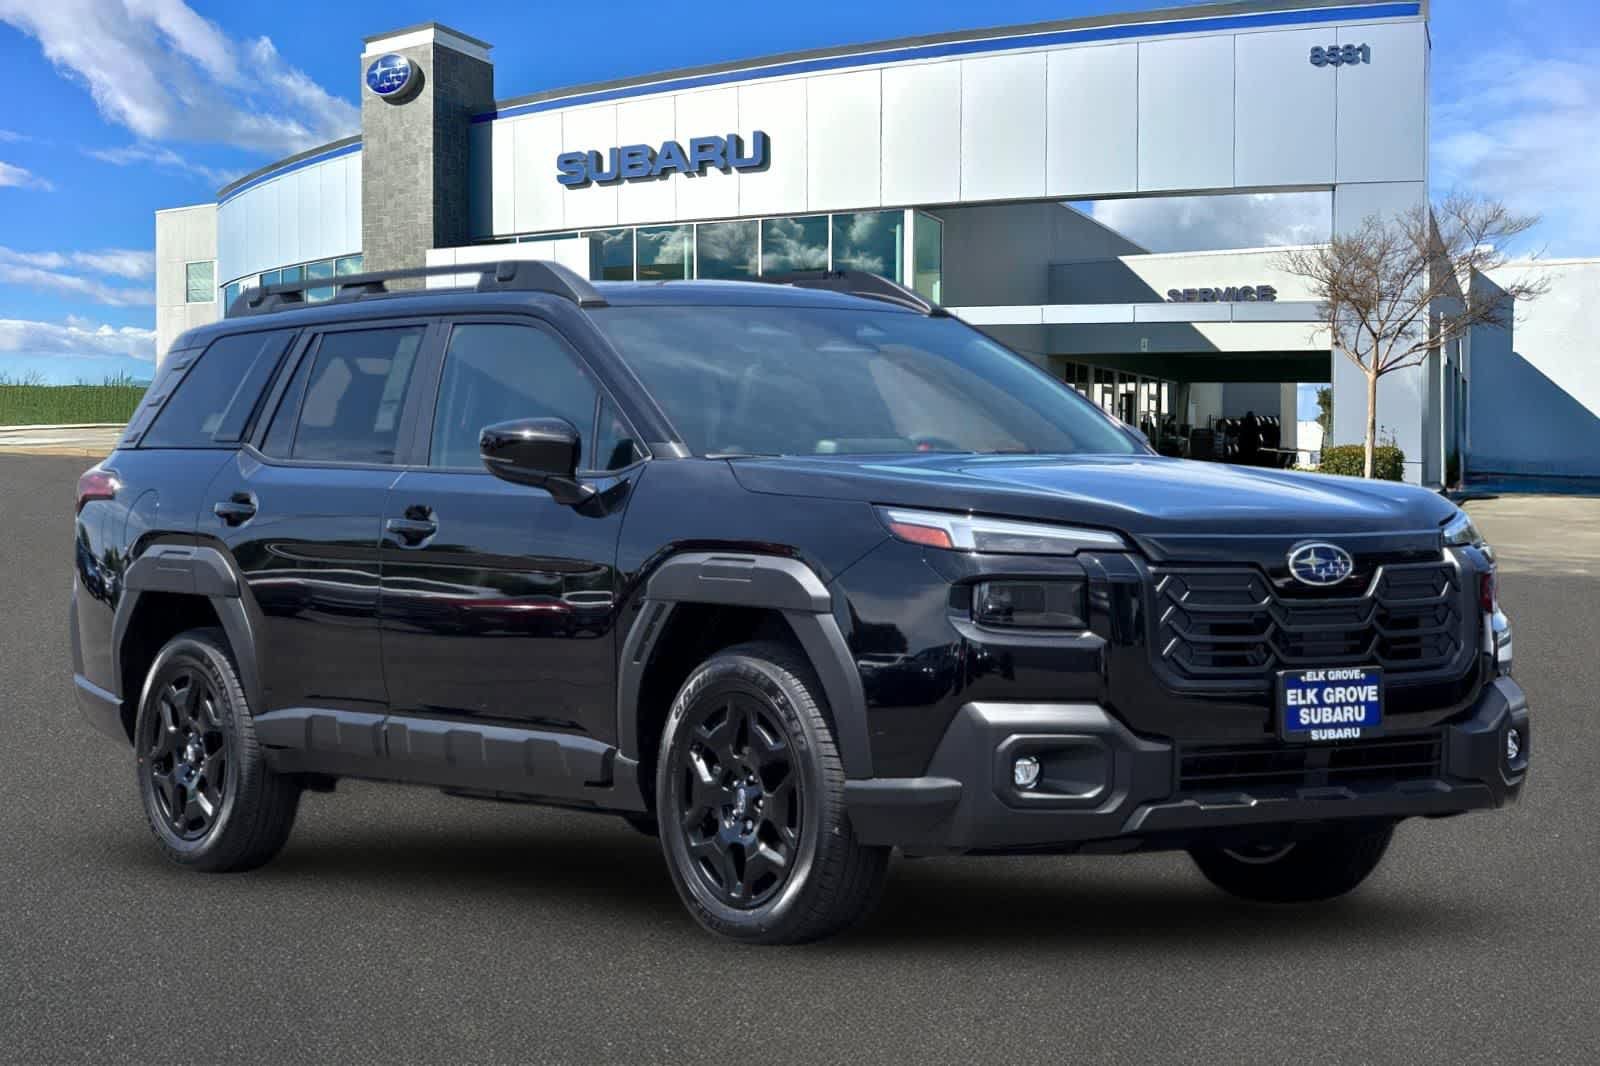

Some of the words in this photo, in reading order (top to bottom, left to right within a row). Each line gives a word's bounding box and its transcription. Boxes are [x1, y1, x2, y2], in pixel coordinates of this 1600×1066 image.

[556, 130, 771, 190] SUBARU
[1167, 285, 1278, 303] SERVICE
[1306, 671, 1326, 681] ELK
[1327, 669, 1361, 681] GROVE
[1286, 687, 1319, 706] ELK
[1322, 685, 1379, 704] GROVE
[1299, 705, 1365, 725] SUBARU
[1311, 727, 1361, 740] SUBARU
